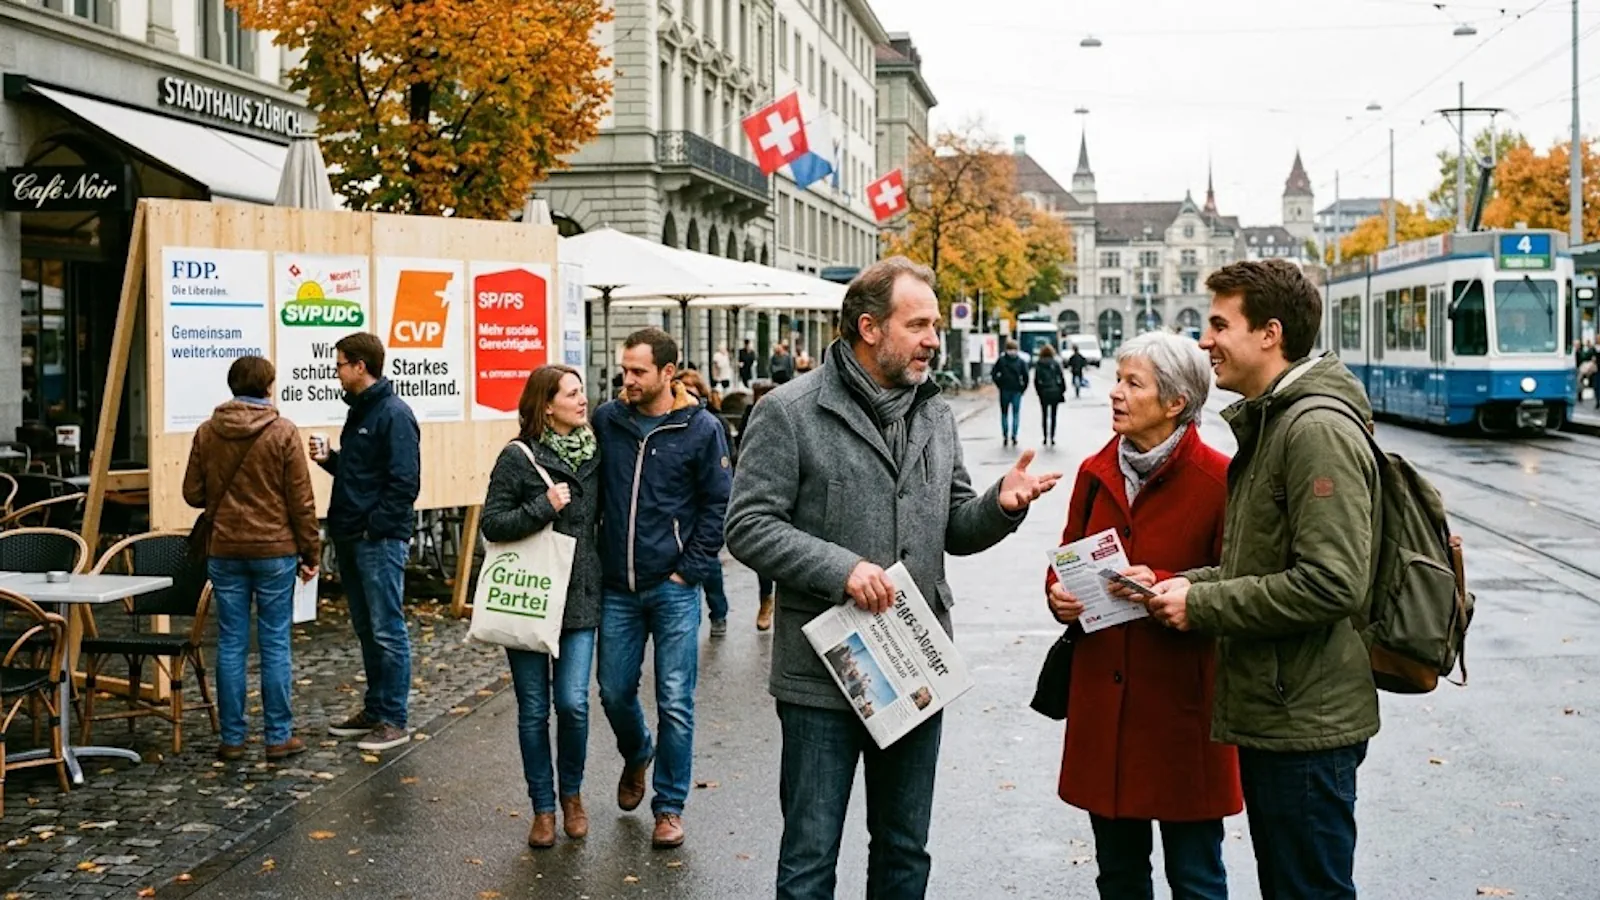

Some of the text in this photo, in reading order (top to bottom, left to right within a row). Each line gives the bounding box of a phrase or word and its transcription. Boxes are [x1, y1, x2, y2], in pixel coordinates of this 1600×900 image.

[164, 76, 302, 136] STADTHAUS ZÜRICH
[12, 172, 117, 208] Café Noir
[1516, 235, 1533, 254] 4
[172, 260, 219, 279] FDP.
[172, 284, 187, 296] Die
[478, 291, 524, 310] SP/PS
[171, 324, 243, 339] Gemeinsam
[394, 320, 441, 342] CVP
[478, 323, 504, 336] Mehr
[311, 342, 336, 359] Wir
[292, 364, 339, 380] schütz
[392, 358, 449, 376] Starkes
[281, 385, 347, 401] die Schw
[491, 566, 552, 590] Grüne
[487, 586, 549, 611] Partei
